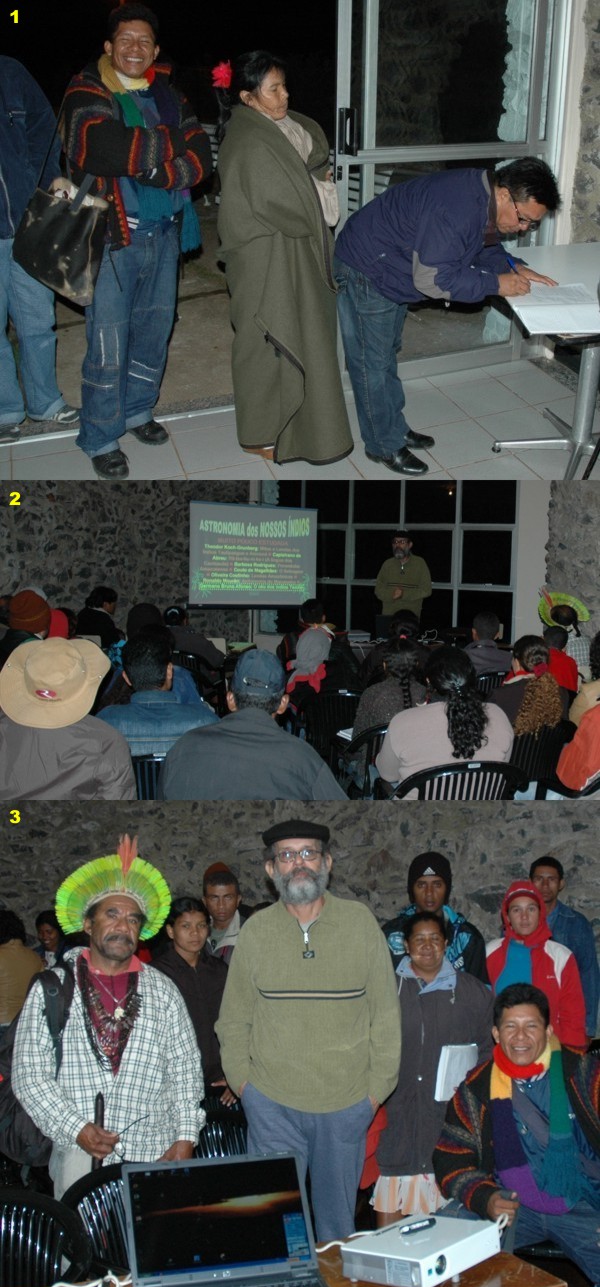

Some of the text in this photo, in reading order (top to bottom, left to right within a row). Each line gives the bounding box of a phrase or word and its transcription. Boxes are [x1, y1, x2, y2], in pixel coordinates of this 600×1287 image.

[199, 515, 310, 538] ASTRONOMIA dos NOSSOS ÍNDIOS
